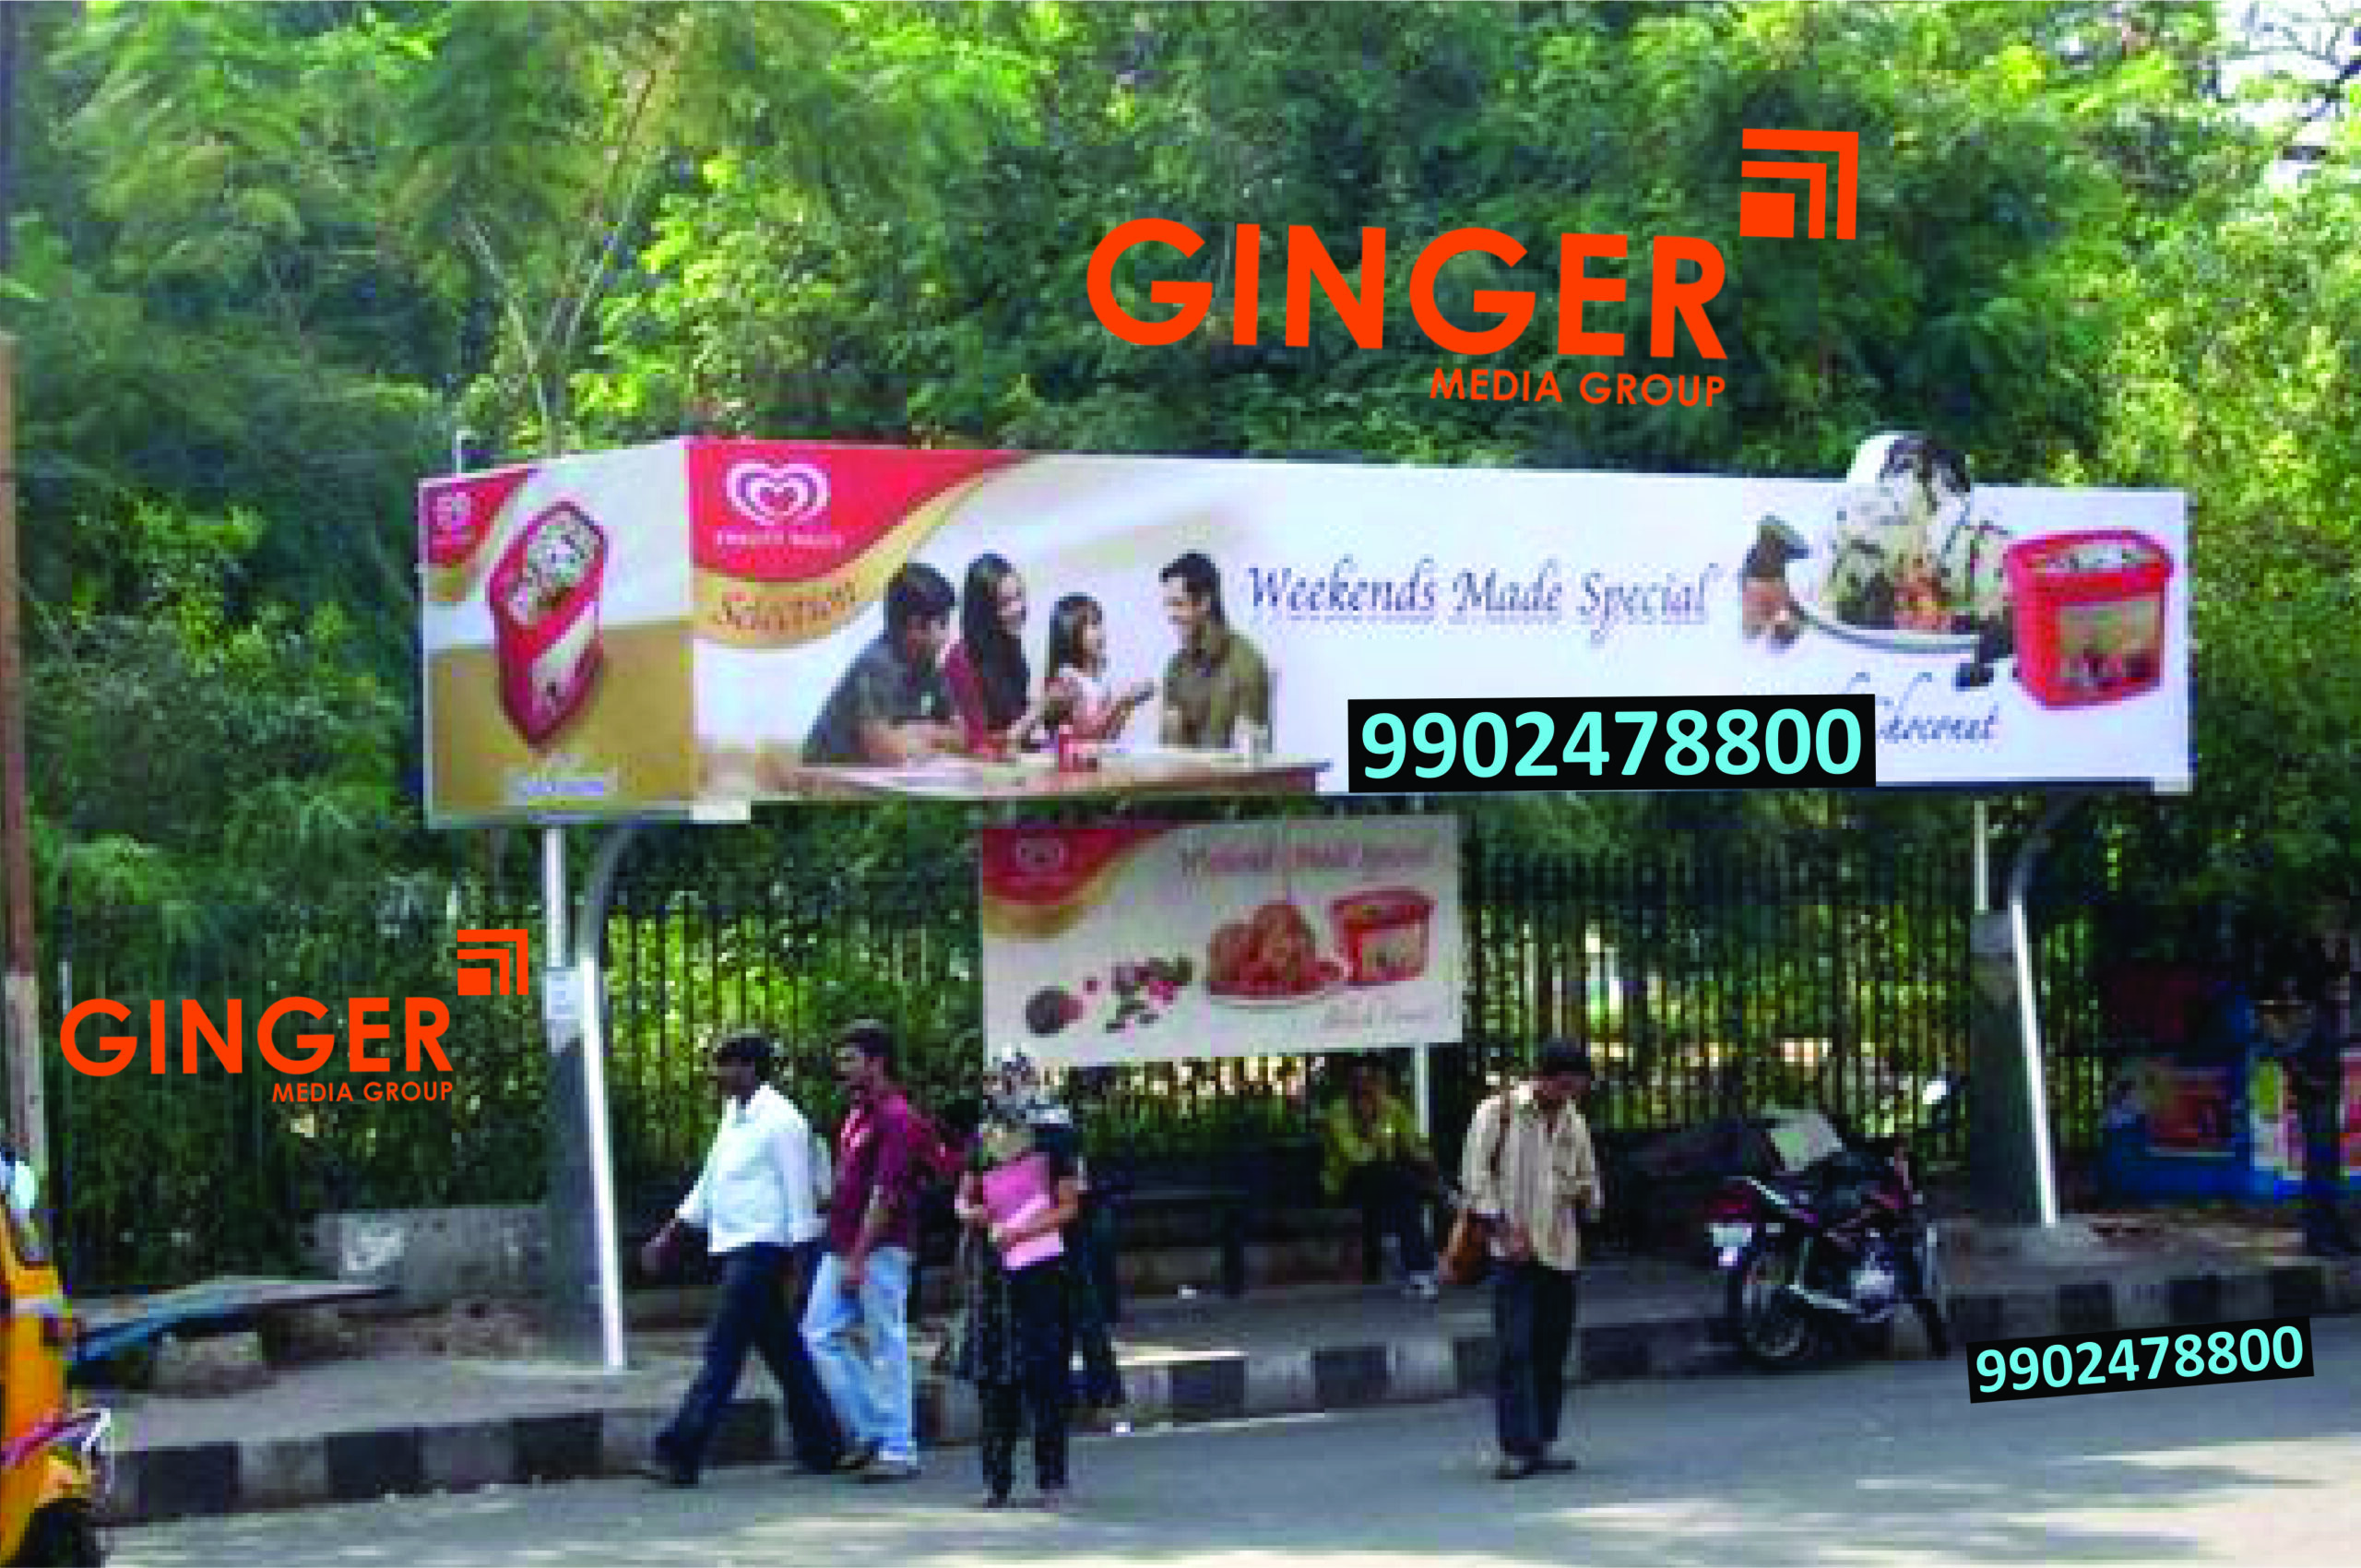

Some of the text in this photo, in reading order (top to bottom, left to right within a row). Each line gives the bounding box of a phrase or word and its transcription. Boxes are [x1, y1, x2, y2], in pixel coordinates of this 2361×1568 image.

[1247, 553, 1721, 647] Weekends Made Special
